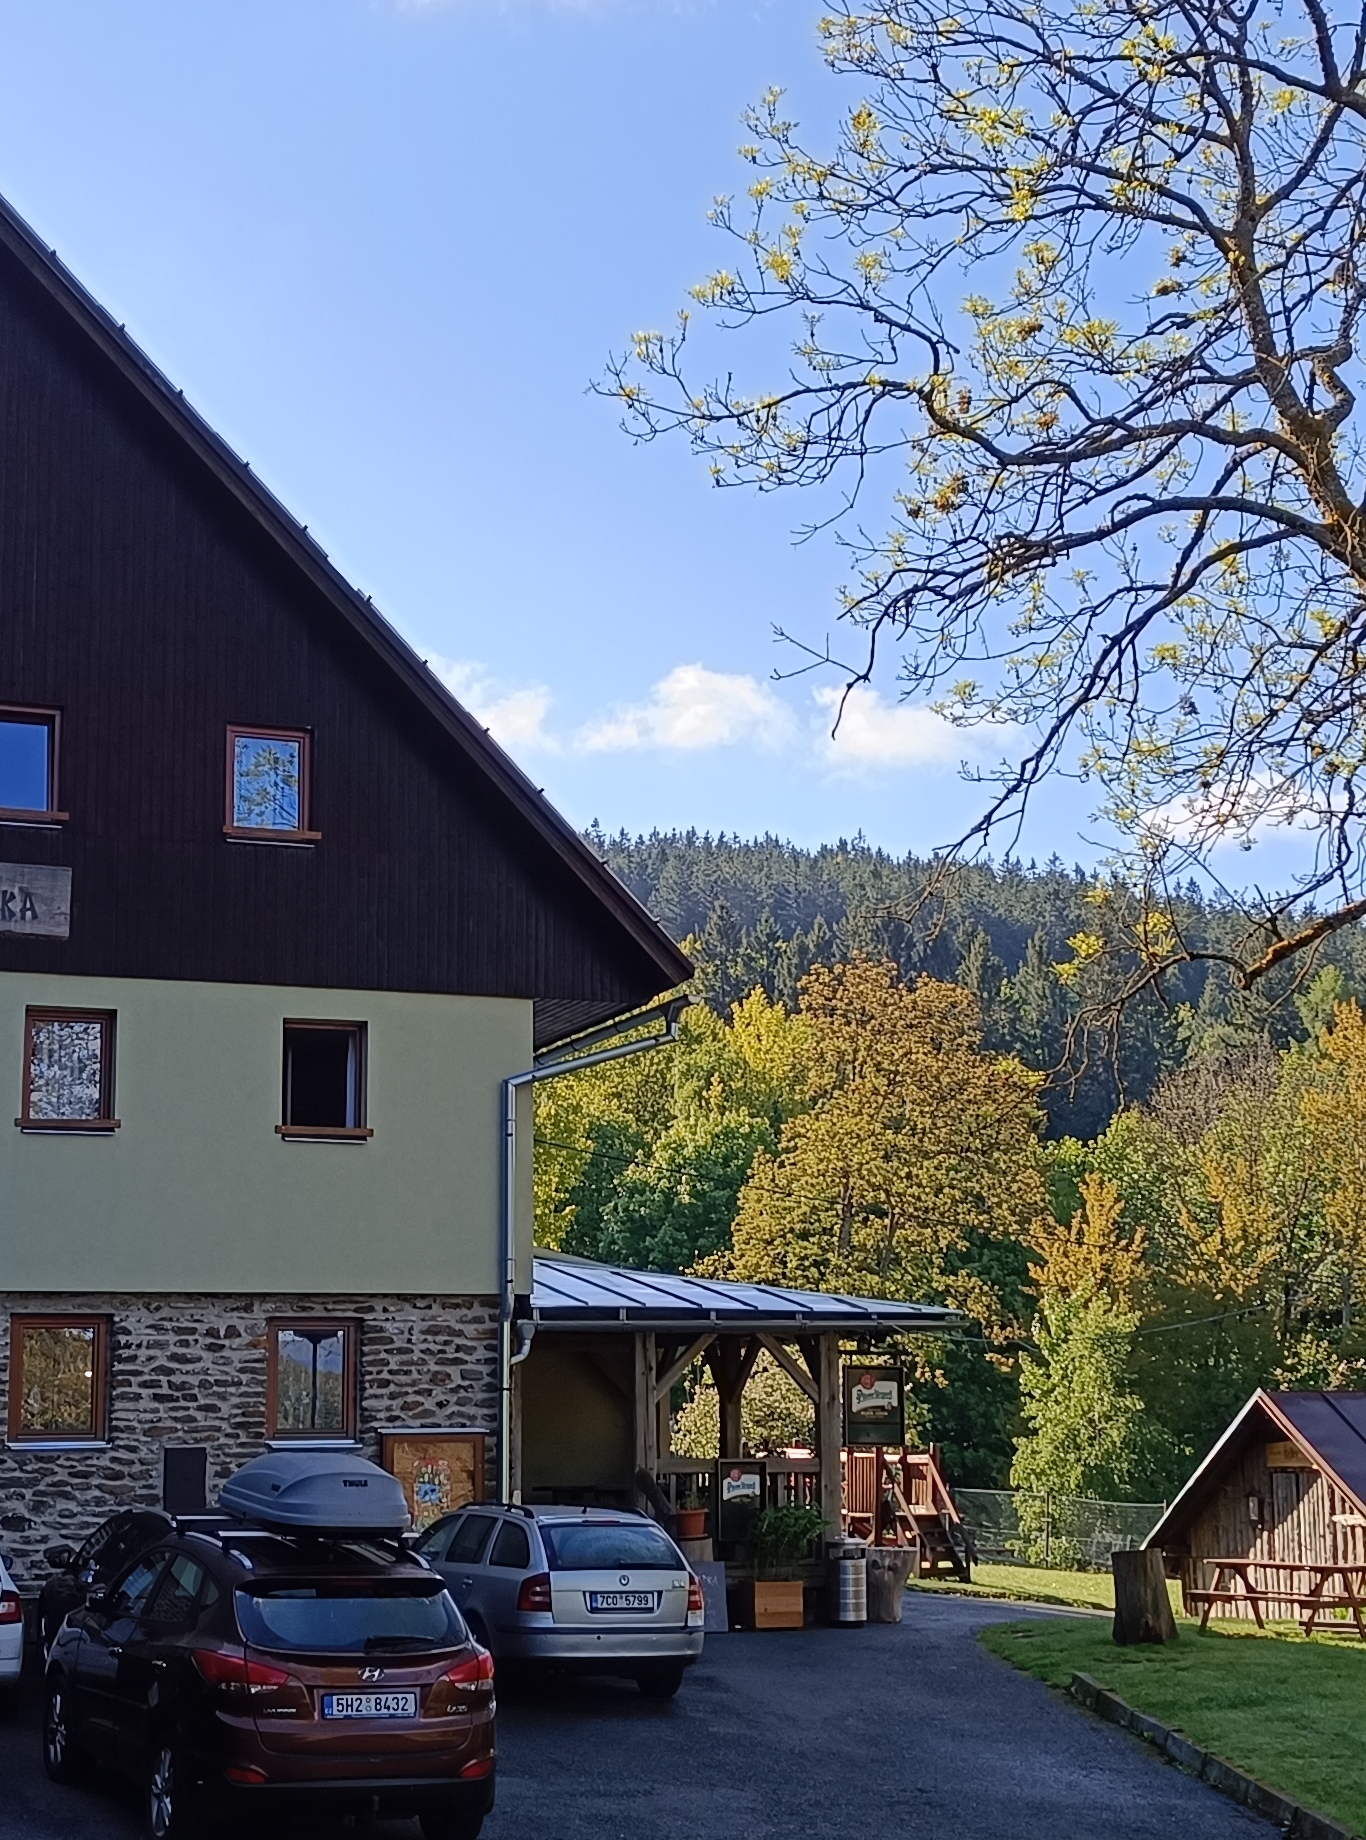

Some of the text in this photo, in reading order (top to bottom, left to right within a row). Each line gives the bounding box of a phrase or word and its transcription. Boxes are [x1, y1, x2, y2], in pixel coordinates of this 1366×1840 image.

[625, 1595, 649, 1606] 5799
[336, 1697, 363, 1713] 5H2
[375, 1696, 409, 1713] 8432
